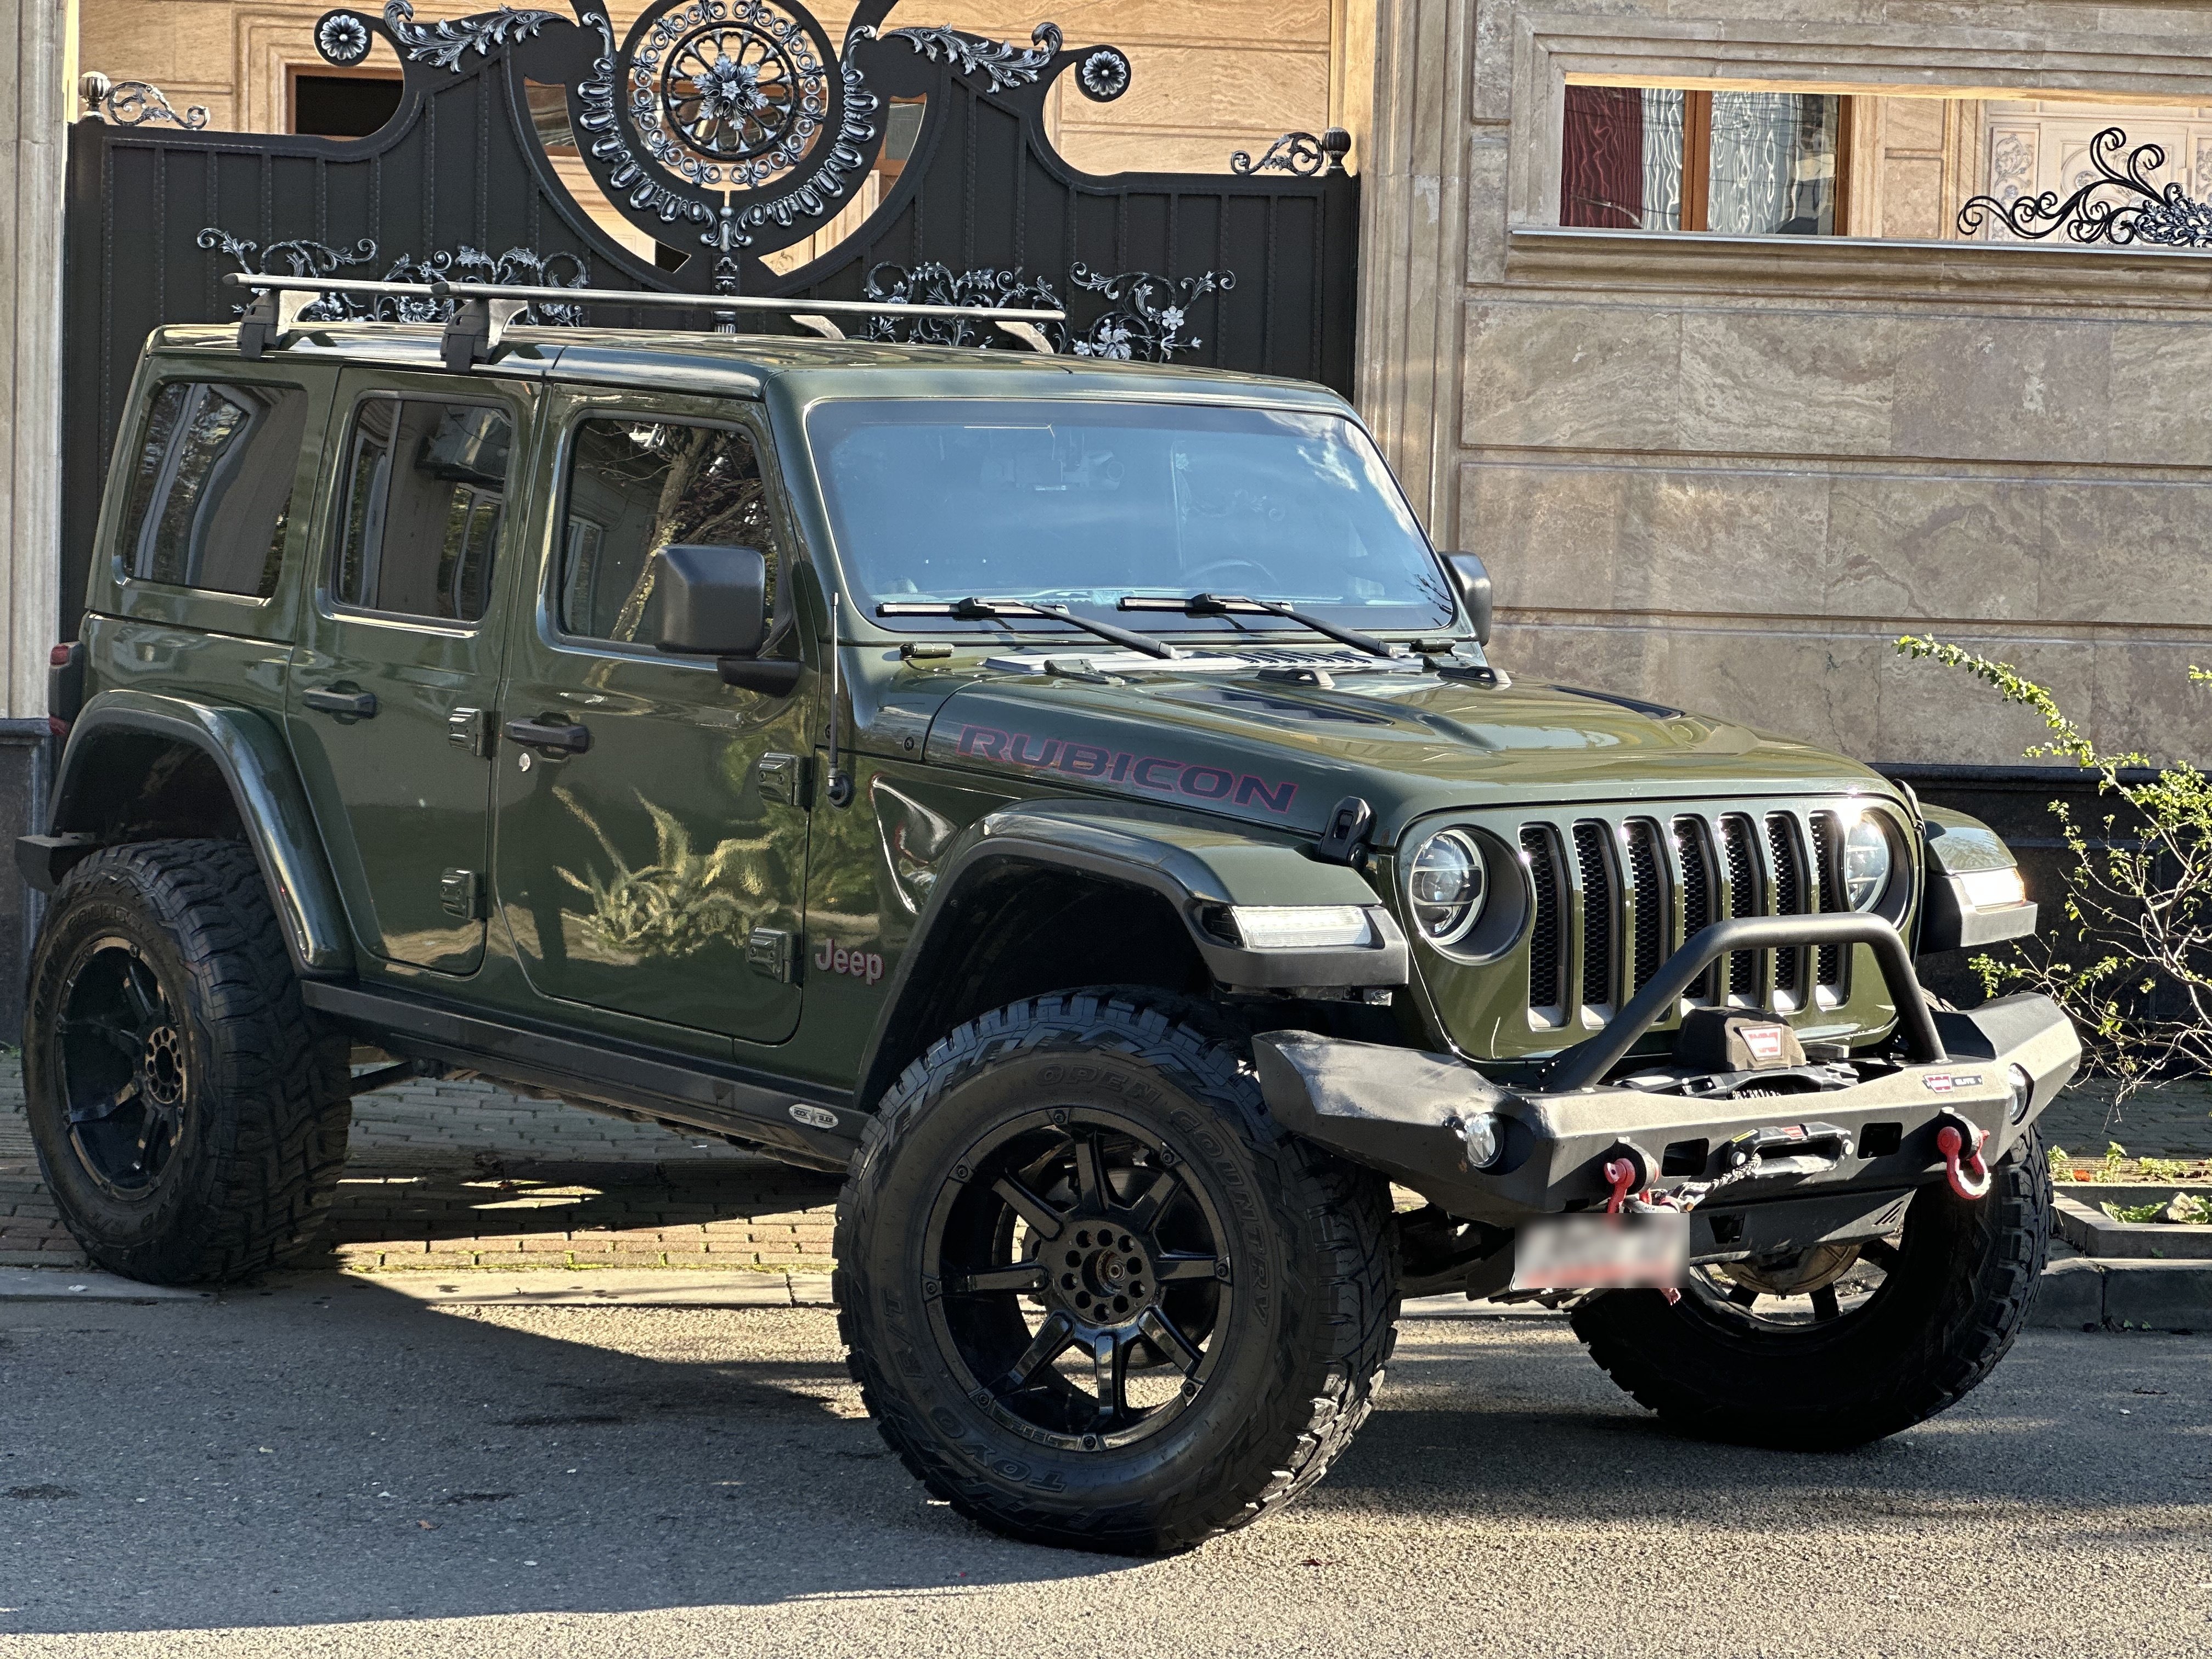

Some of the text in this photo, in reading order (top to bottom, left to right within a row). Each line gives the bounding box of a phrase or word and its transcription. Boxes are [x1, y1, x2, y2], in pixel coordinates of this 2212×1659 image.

[956, 724, 1299, 813] RUBICON
[814, 938, 885, 986] Jeep
[1034, 1063, 1271, 1328] OPEN COUNTRY
[928, 1406, 1067, 1493] TOYO
